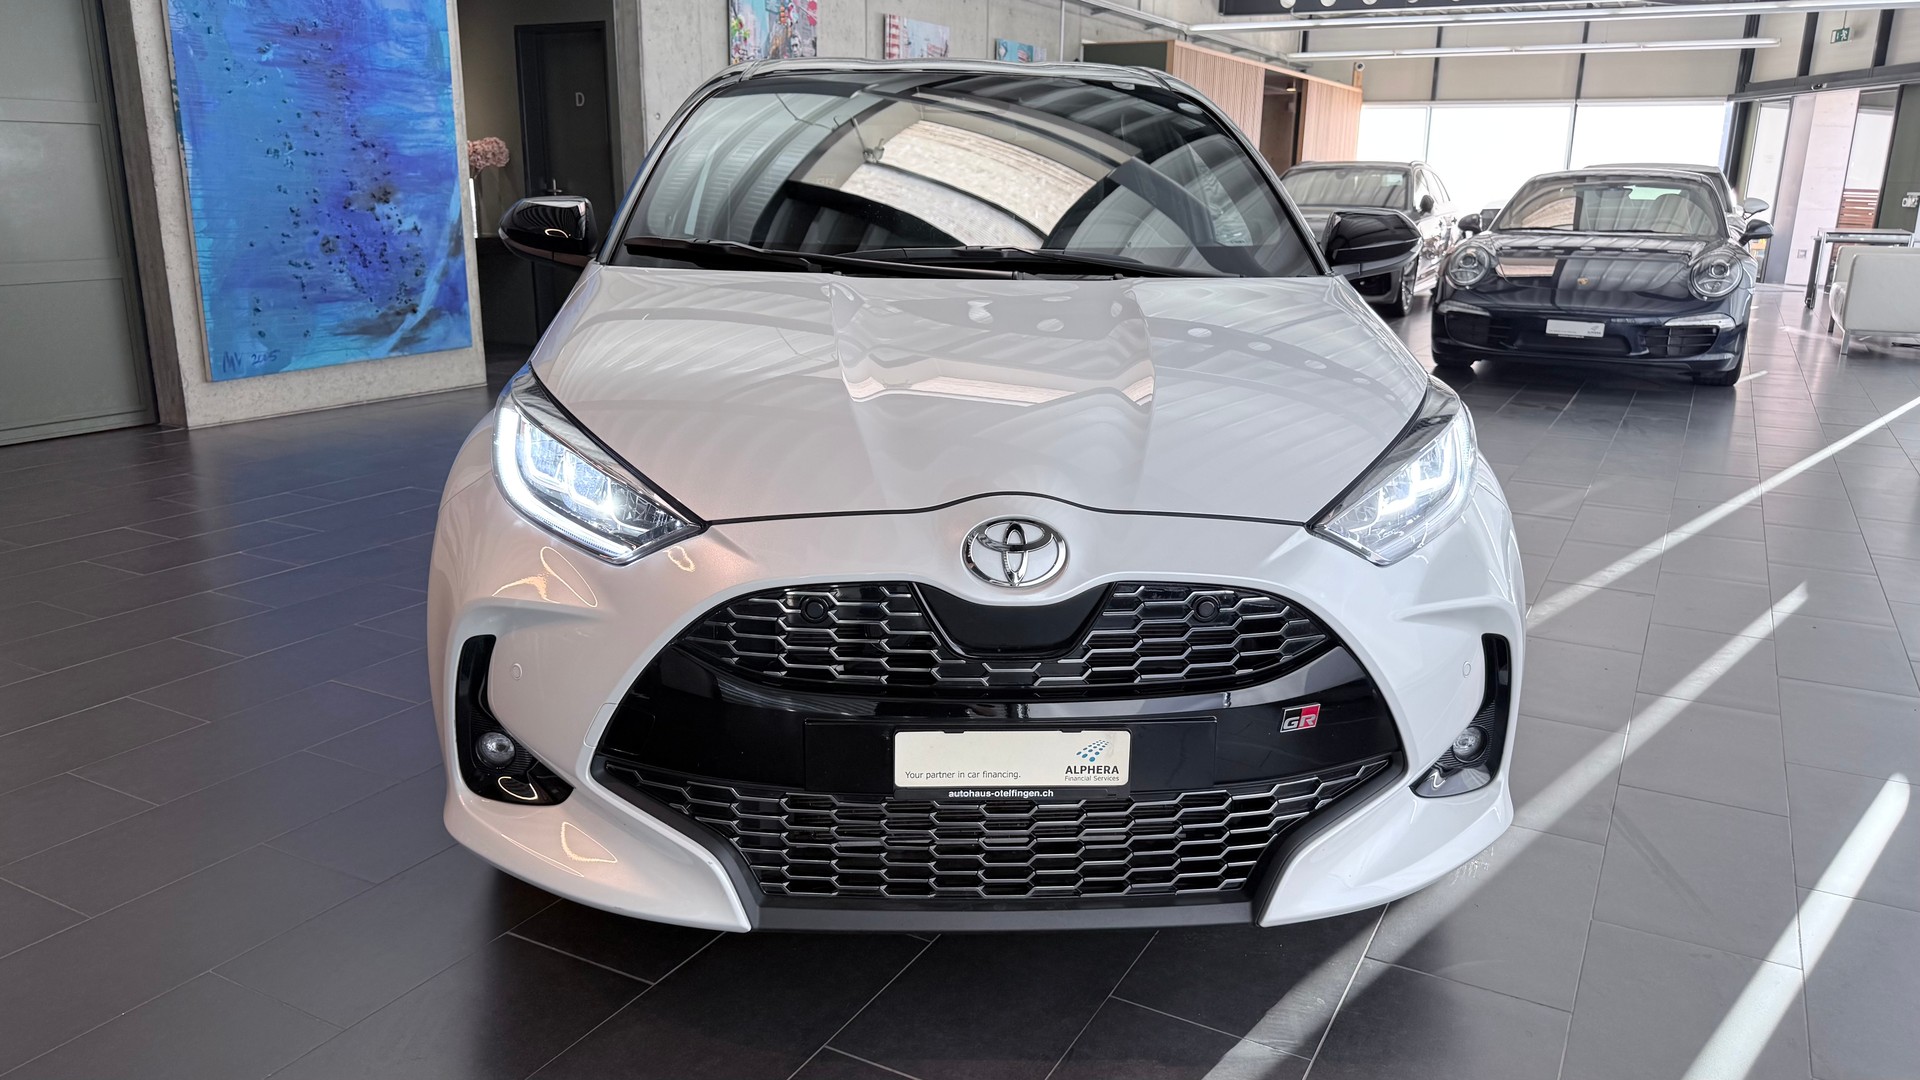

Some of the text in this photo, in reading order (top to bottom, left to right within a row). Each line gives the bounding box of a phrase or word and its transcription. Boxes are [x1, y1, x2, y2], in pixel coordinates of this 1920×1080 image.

[575, 91, 585, 107] D
[1283, 714, 1316, 729] GR
[905, 771, 924, 779] Your
[926, 771, 955, 780] partner
[957, 771, 966, 779] in
[982, 770, 1021, 780] financing.
[1065, 765, 1120, 775] ALPHERA
[948, 789, 1054, 798] autohaus-otelfingen.ch
